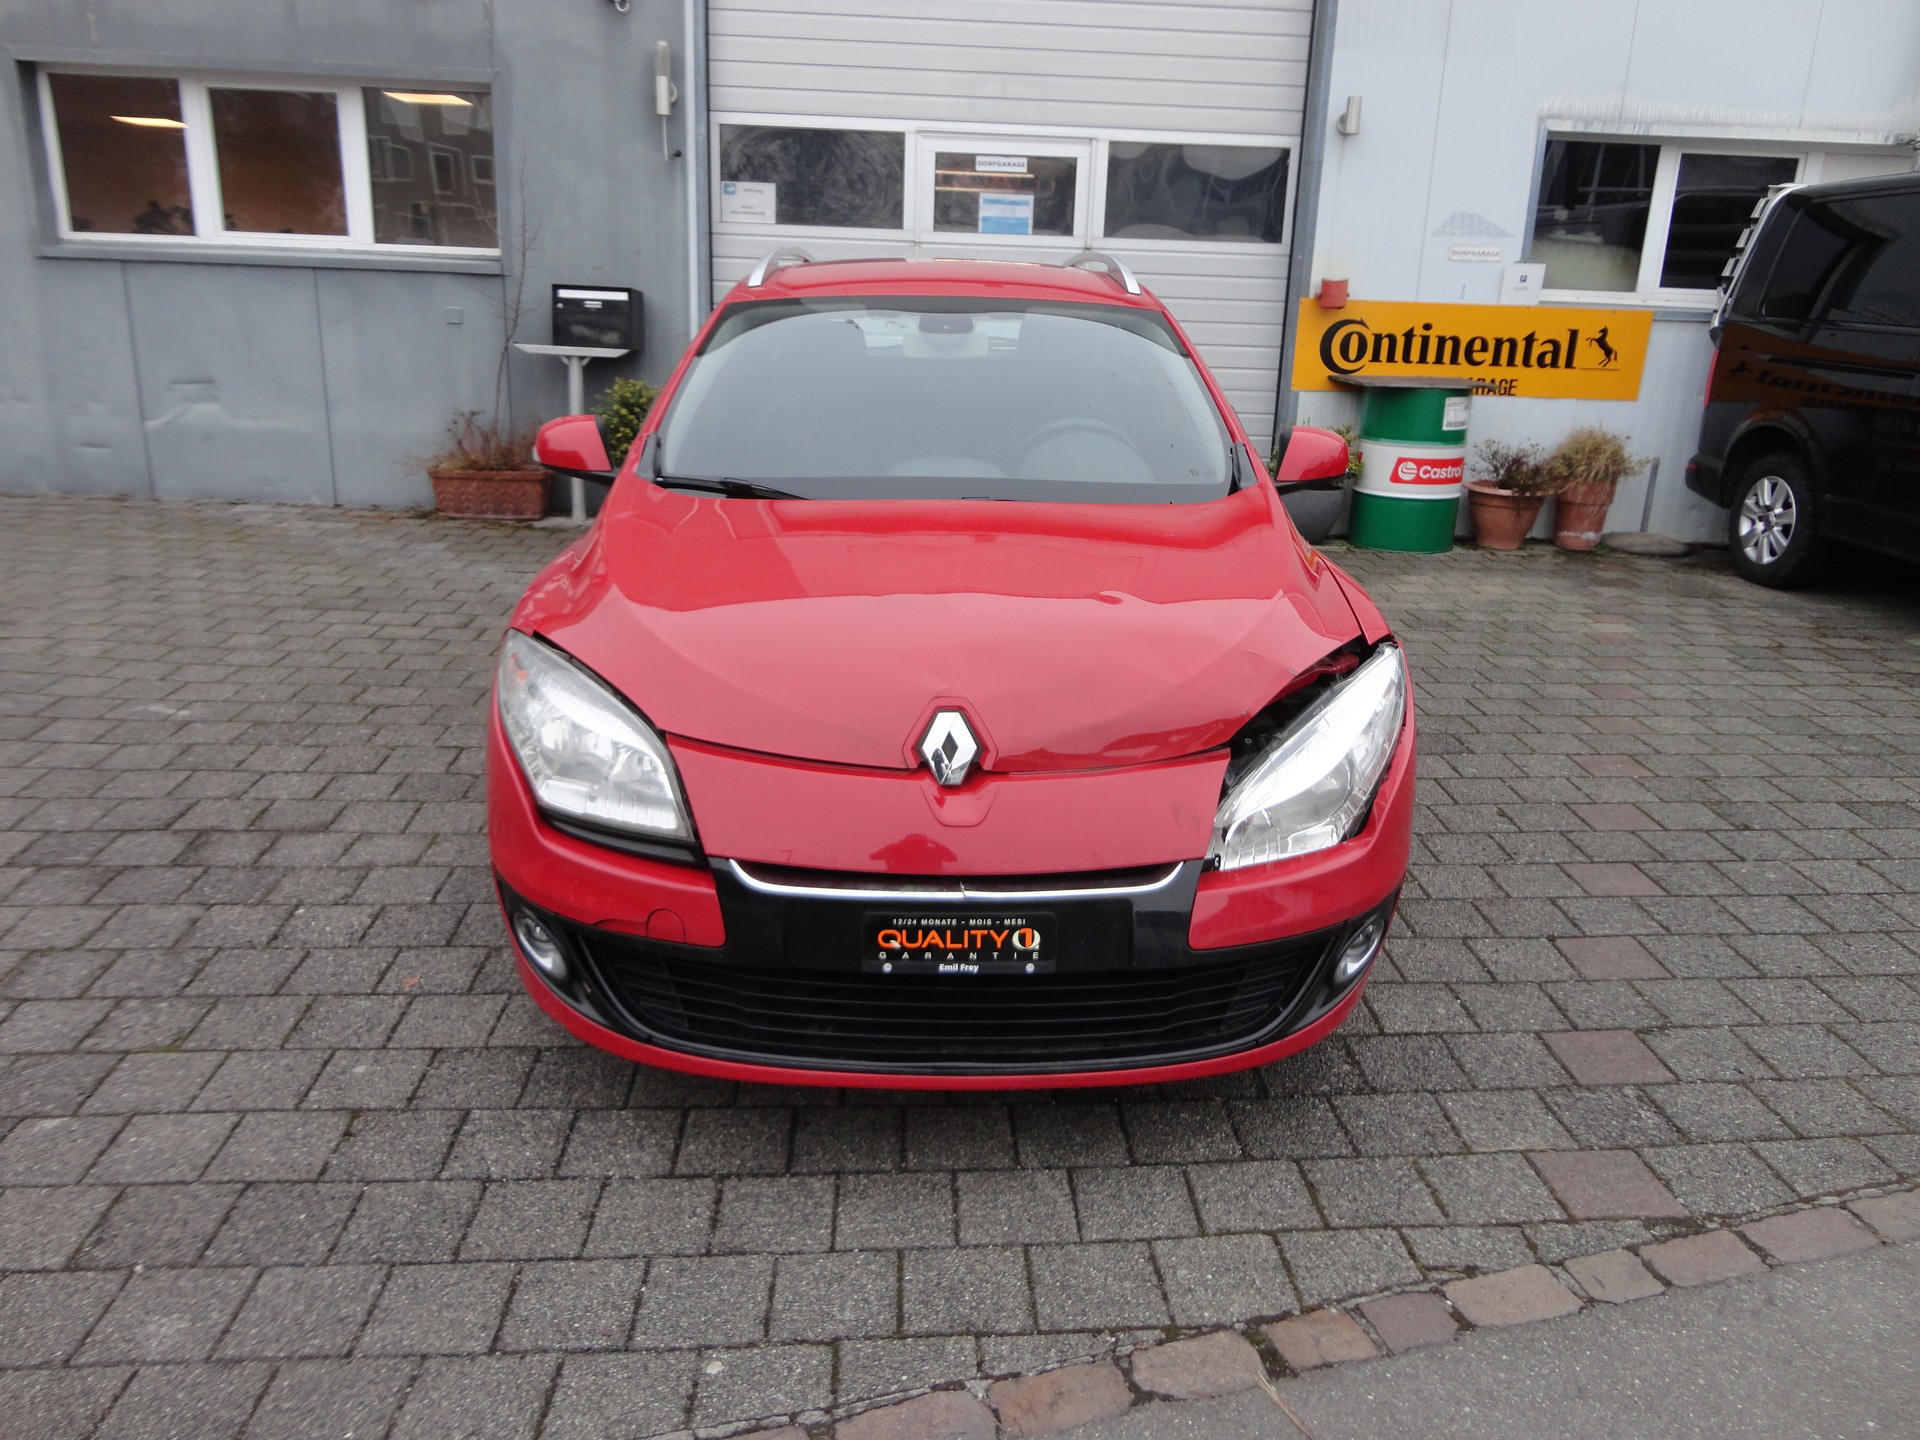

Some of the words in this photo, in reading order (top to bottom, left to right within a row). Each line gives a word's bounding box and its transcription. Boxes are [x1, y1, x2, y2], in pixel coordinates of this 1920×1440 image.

[1319, 317, 1580, 375] Continental
[921, 918, 957, 926] MONATE
[969, 918, 991, 926] MOIS
[1004, 918, 1026, 926] MESI
[877, 929, 1009, 949] QUALITY
[879, 951, 1039, 960] GARANTIE
[939, 963, 958, 972] Emil
[960, 963, 979, 974] Frey
